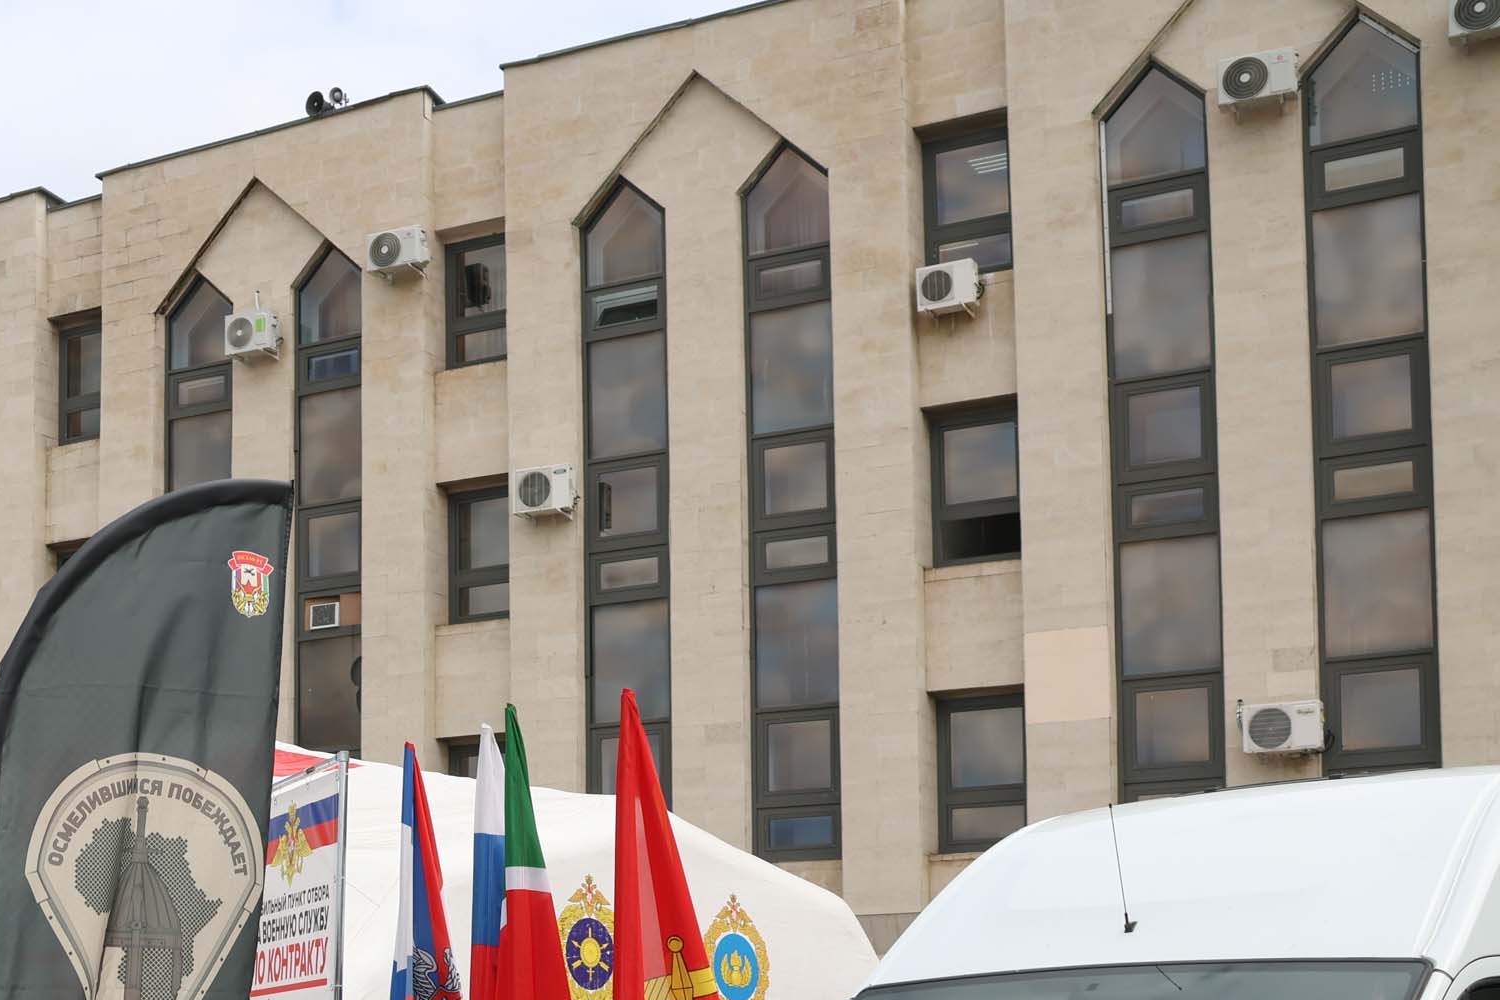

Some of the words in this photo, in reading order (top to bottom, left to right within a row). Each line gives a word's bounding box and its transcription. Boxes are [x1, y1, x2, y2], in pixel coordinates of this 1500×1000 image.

[168, 782, 248, 877] ПОБЕЖДАЕТ
[287, 890, 306, 908] ПУНКТ
[307, 884, 329, 904] ОТБОРА
[262, 914, 296, 944] ВОЕННУЮ
[298, 906, 329, 936] СЛУЖБУ
[267, 936, 328, 983] КОНТРАКТУ
